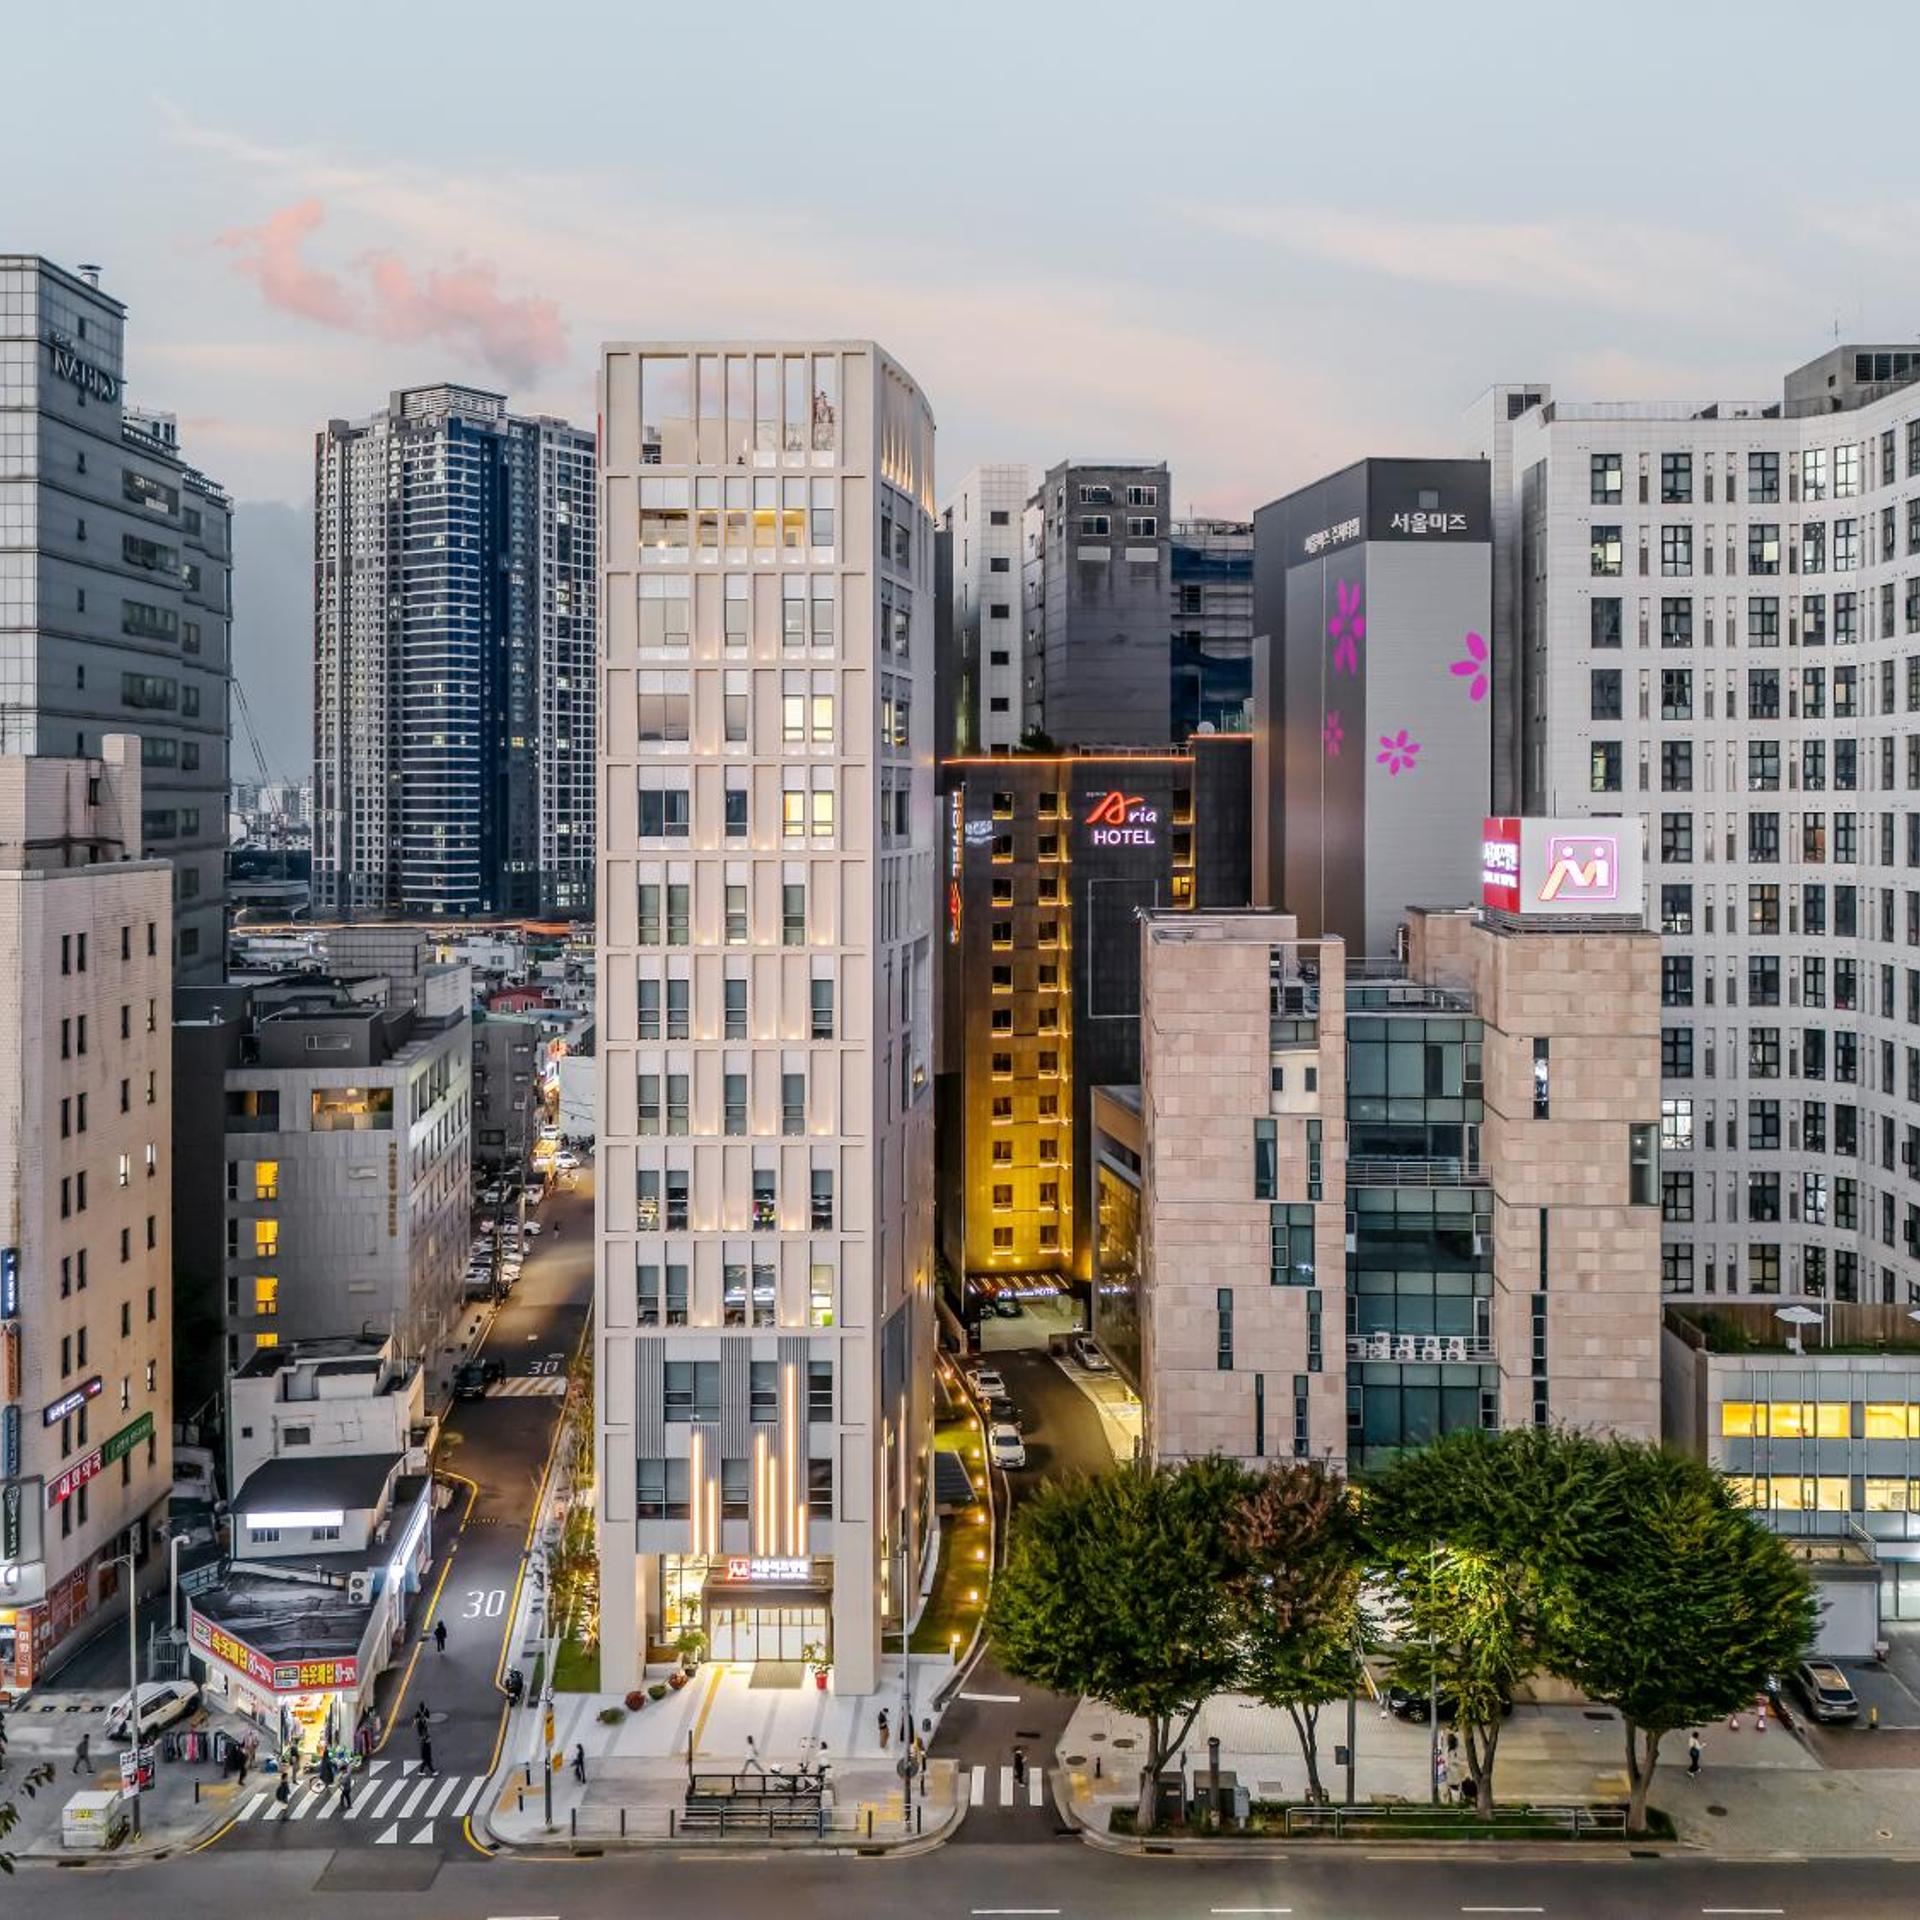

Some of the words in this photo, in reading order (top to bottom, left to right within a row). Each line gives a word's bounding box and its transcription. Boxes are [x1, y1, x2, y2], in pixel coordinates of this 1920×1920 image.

[1391, 513, 1467, 533] 서울미즈
[1085, 791, 1157, 824] Aria
[1094, 830, 1156, 845] HOTEL
[527, 1361, 559, 1375] 30
[462, 1590, 506, 1618] 30
